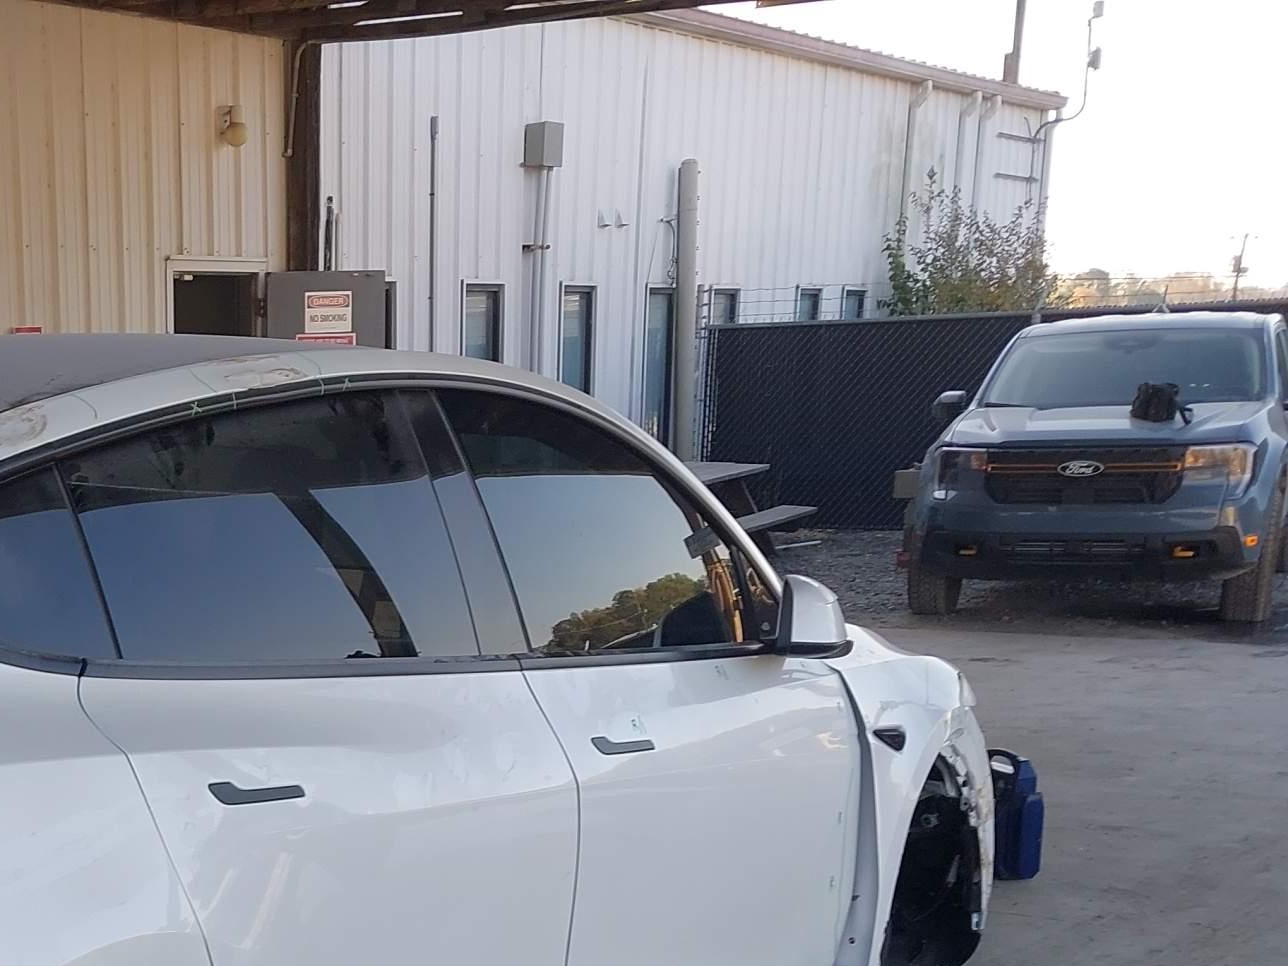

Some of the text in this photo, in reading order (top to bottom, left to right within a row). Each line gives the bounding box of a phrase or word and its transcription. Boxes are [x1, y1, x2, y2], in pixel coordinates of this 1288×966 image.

[312, 297, 344, 305] DANGER
[309, 313, 348, 322] NO SMOKING
[1065, 463, 1096, 474] Ford
